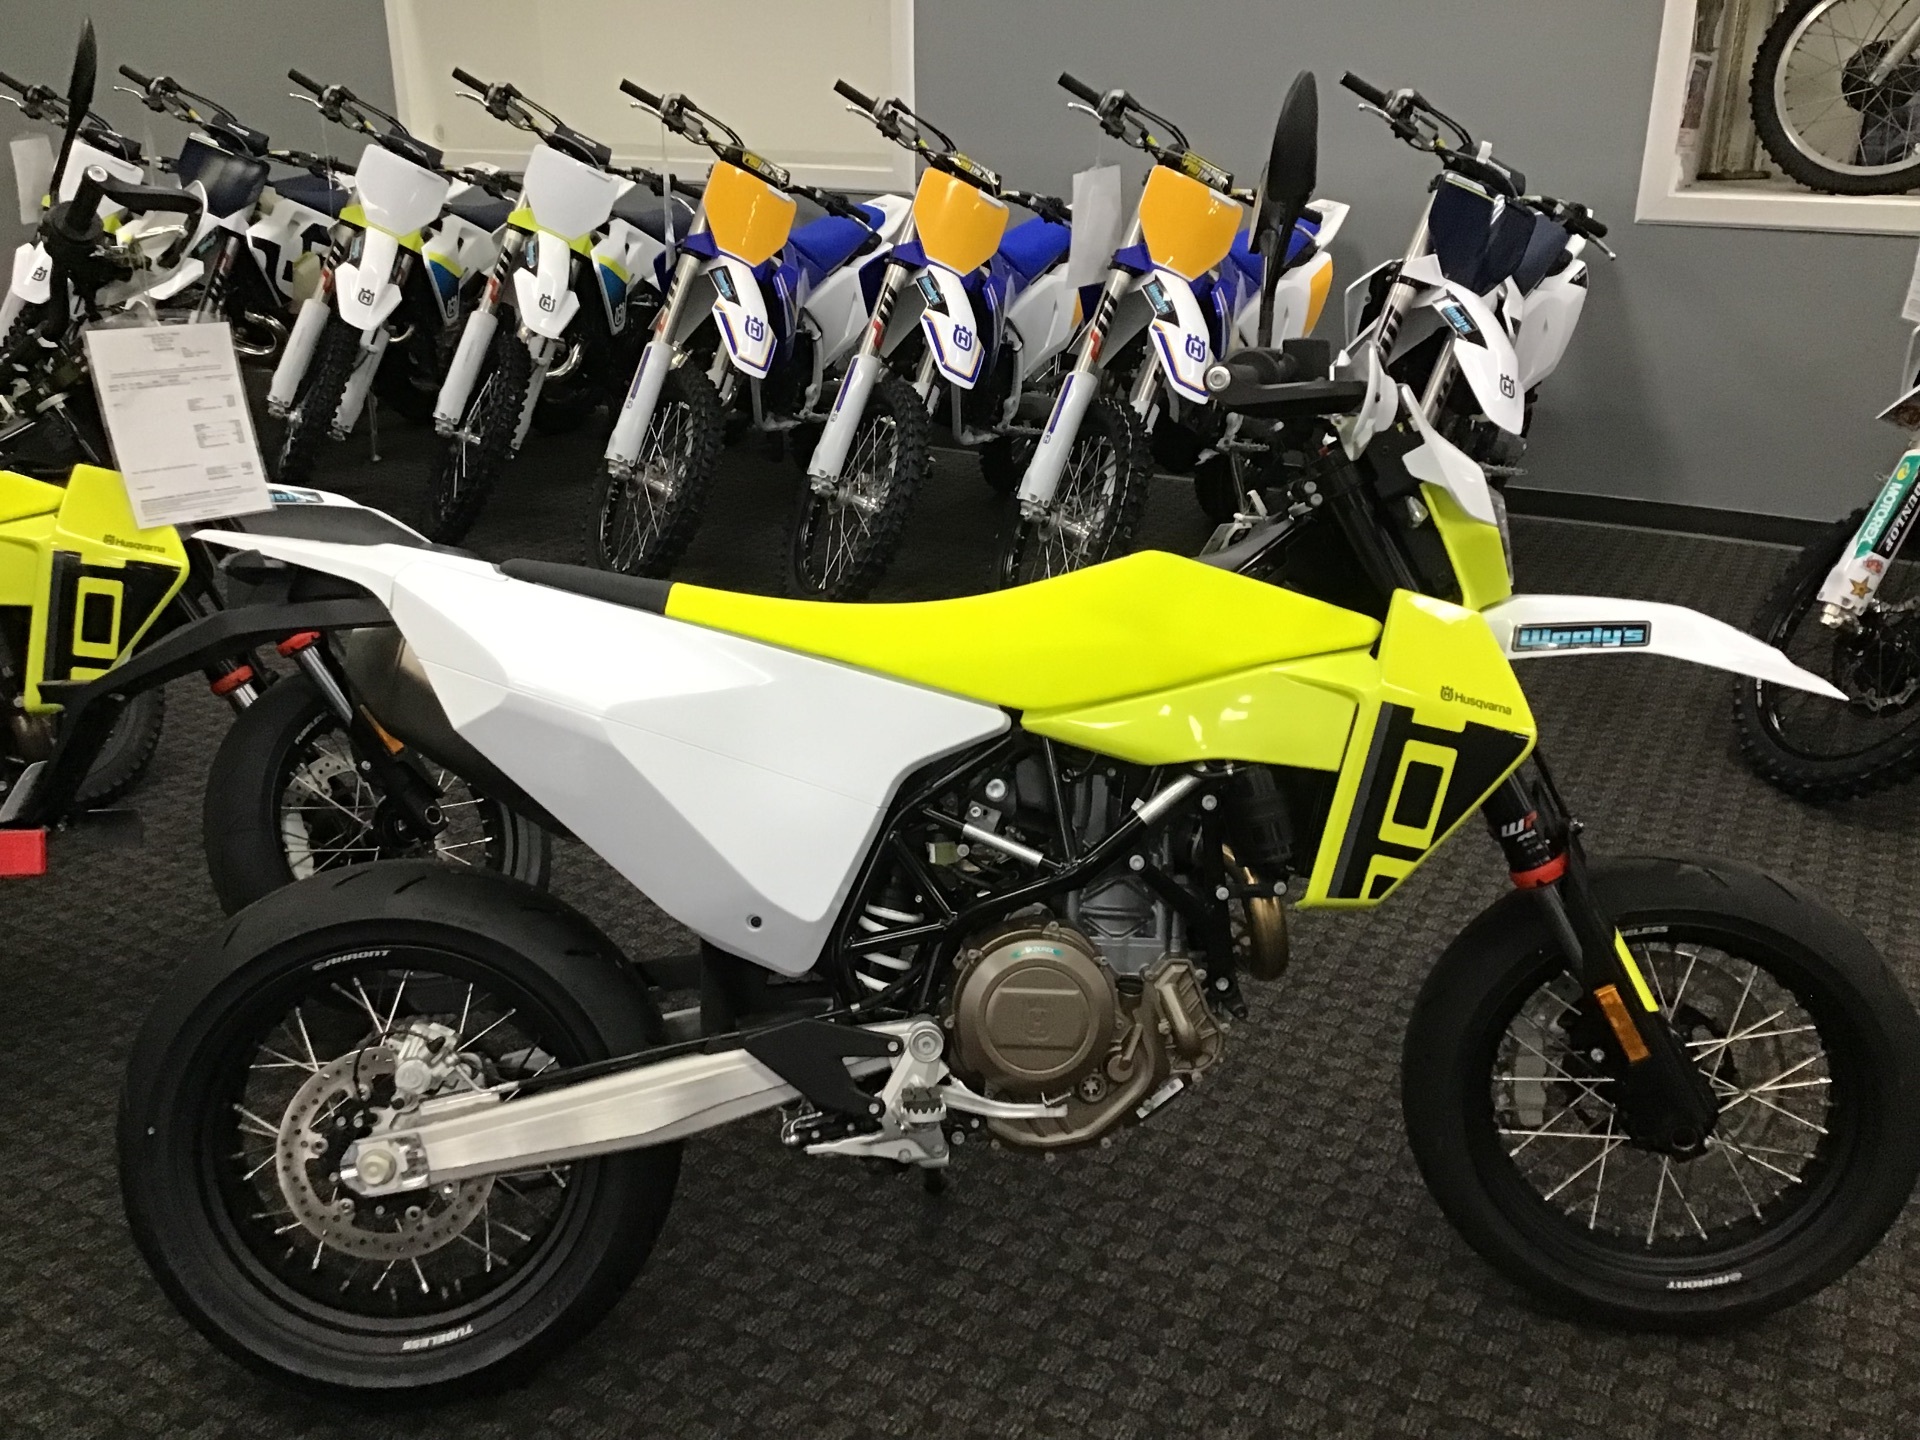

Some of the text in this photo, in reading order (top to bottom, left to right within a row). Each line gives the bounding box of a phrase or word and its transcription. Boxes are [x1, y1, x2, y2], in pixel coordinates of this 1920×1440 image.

[1859, 481, 1903, 546] MOTOREX
[115, 537, 166, 553] Husqvarna
[1519, 627, 1644, 647] Wooly's
[1454, 692, 1512, 715] Husqvarna
